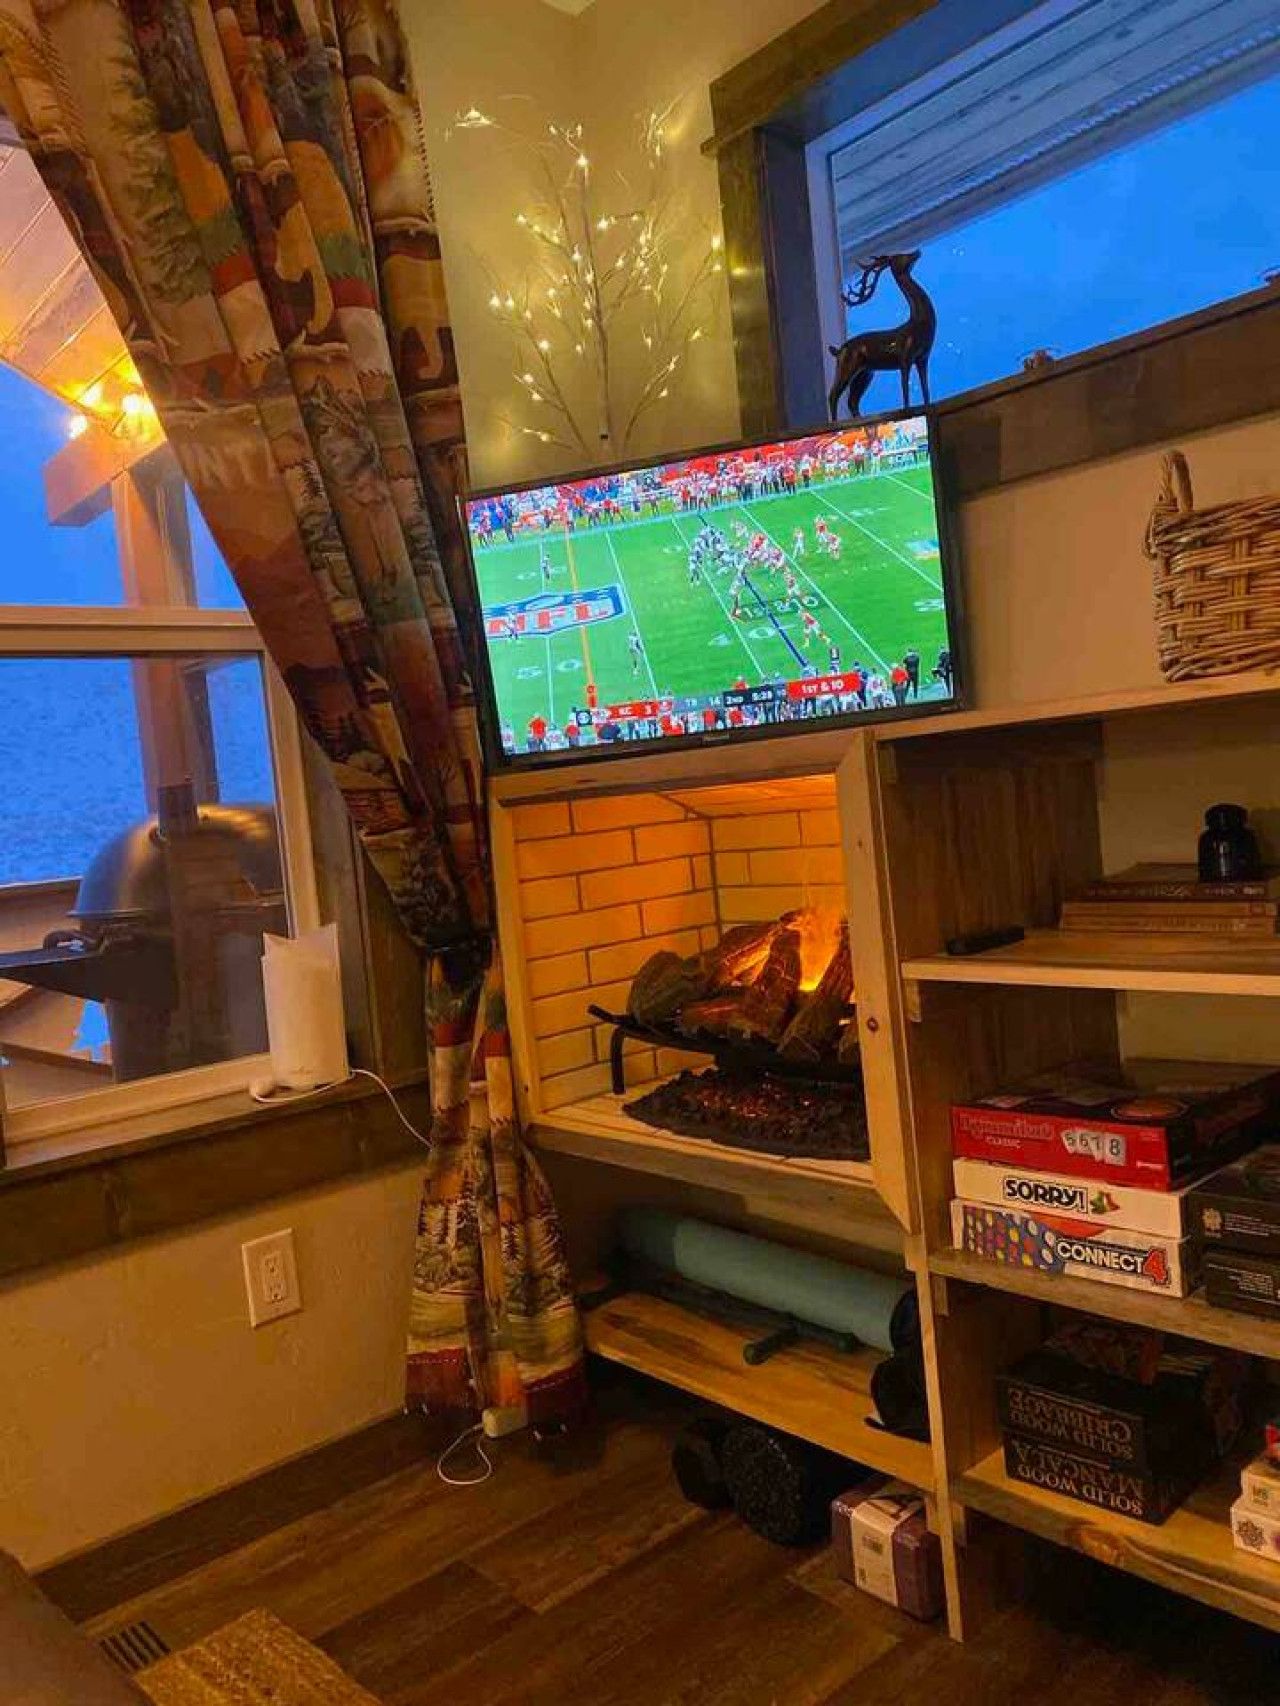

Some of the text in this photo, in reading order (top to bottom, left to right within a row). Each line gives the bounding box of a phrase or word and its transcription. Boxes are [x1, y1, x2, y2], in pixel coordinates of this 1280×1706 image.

[1005, 1178, 1087, 1211] SORRY!
[1056, 1239, 1144, 1275] CONNECT
[1142, 1247, 1169, 1286] 4
[1017, 1463, 1144, 1516] SOLID WOOD
